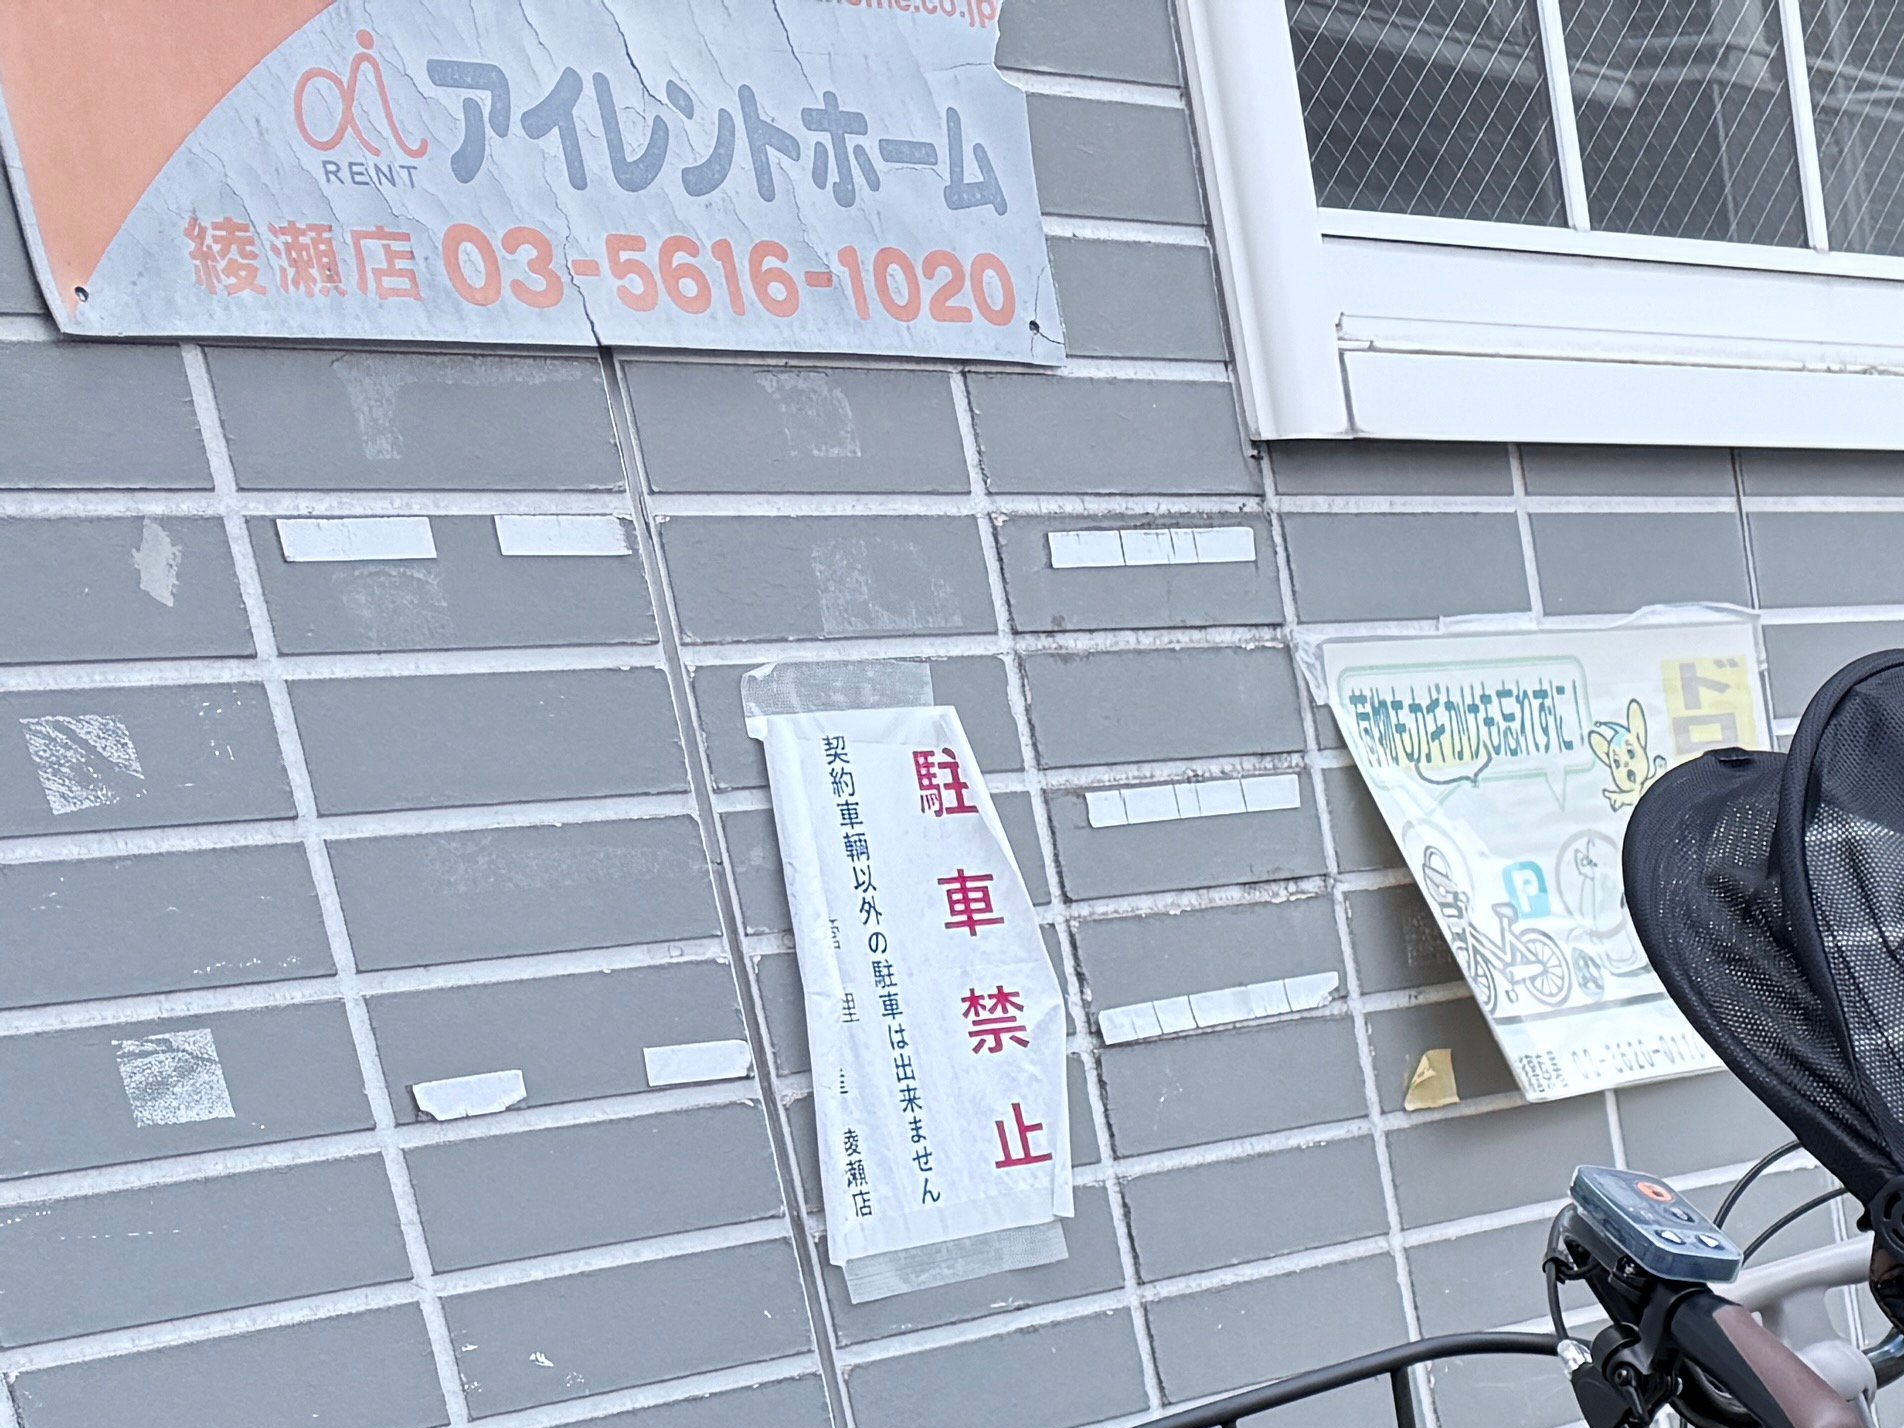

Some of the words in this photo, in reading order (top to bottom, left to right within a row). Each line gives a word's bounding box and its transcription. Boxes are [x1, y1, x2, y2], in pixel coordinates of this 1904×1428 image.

[321, 159, 419, 190] RENT
[427, 58, 1008, 217] アイレントホーム
[182, 216, 423, 302] 綾瀬店
[441, 222, 1016, 327] 03-5616-1020
[911, 746, 1054, 1170] 駐車禁止
